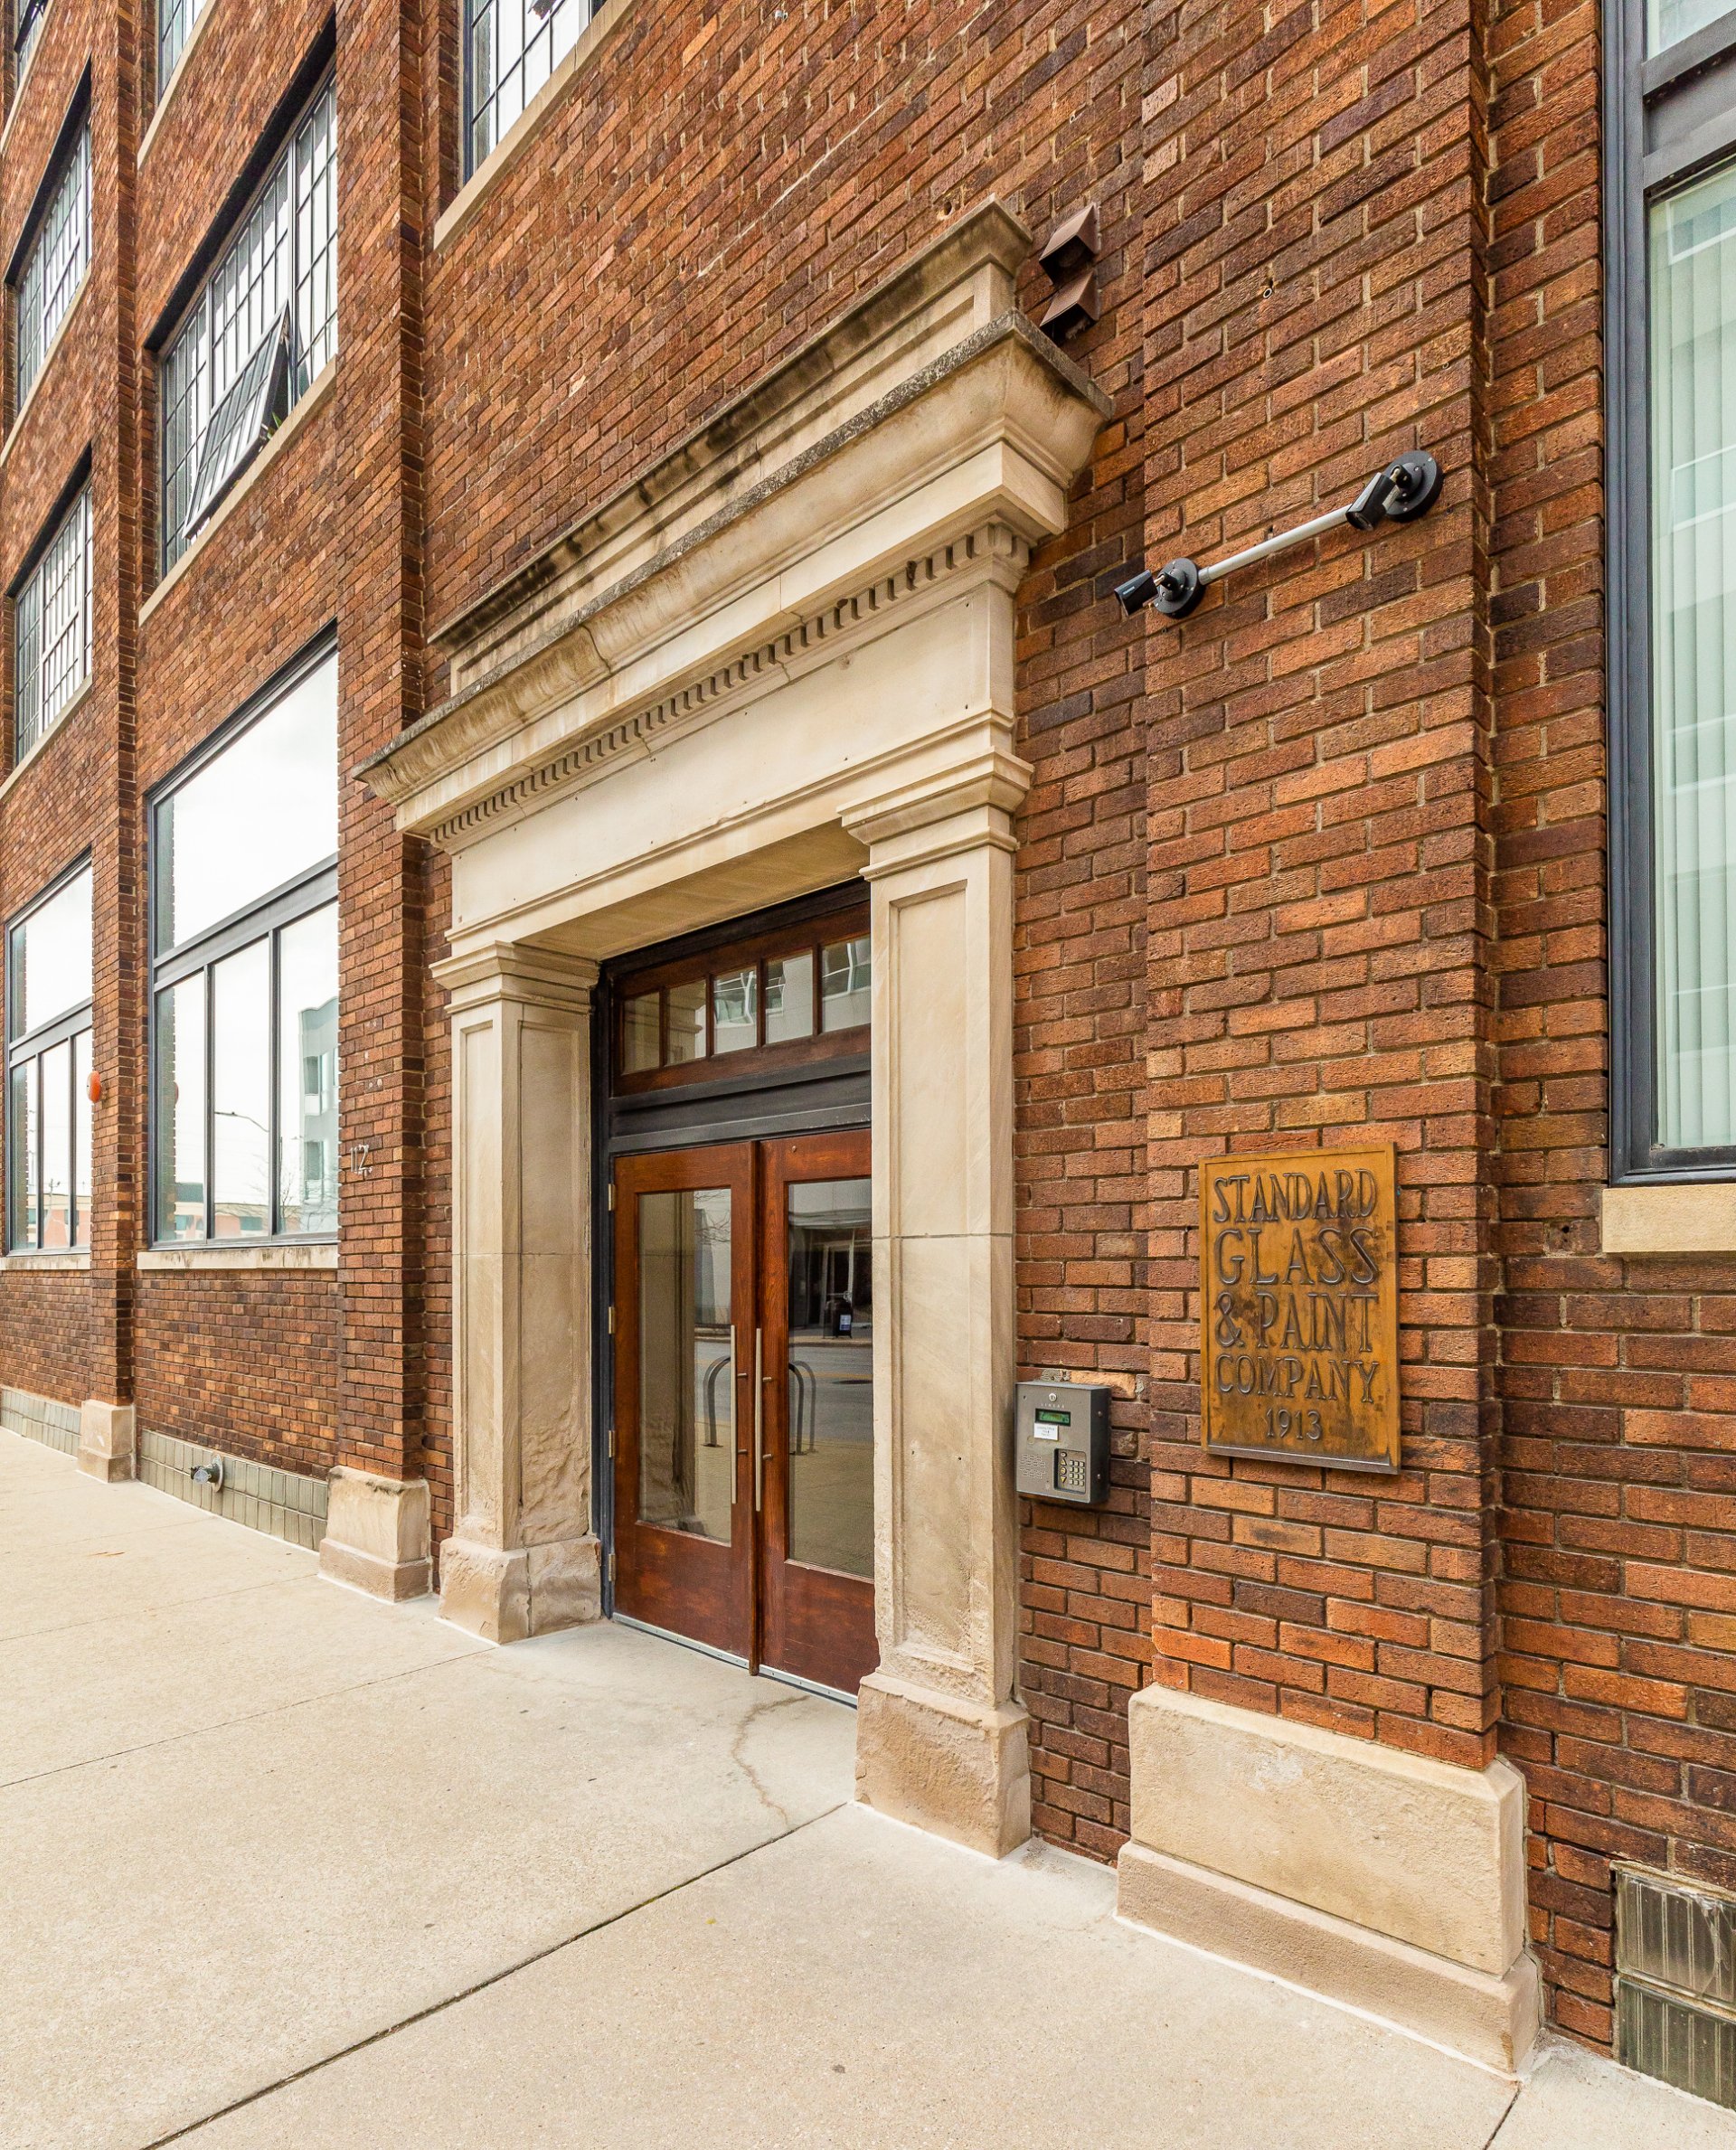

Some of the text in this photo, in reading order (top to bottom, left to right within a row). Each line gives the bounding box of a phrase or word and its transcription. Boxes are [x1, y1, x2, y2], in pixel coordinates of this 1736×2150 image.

[1213, 1167, 1378, 1223] STANDARD
[1213, 1227, 1380, 1286] GLASS
[1214, 1291, 1380, 1353] & PAINT
[1215, 1354, 1381, 1404] COMPANY
[1266, 1409, 1323, 1441] 1913
